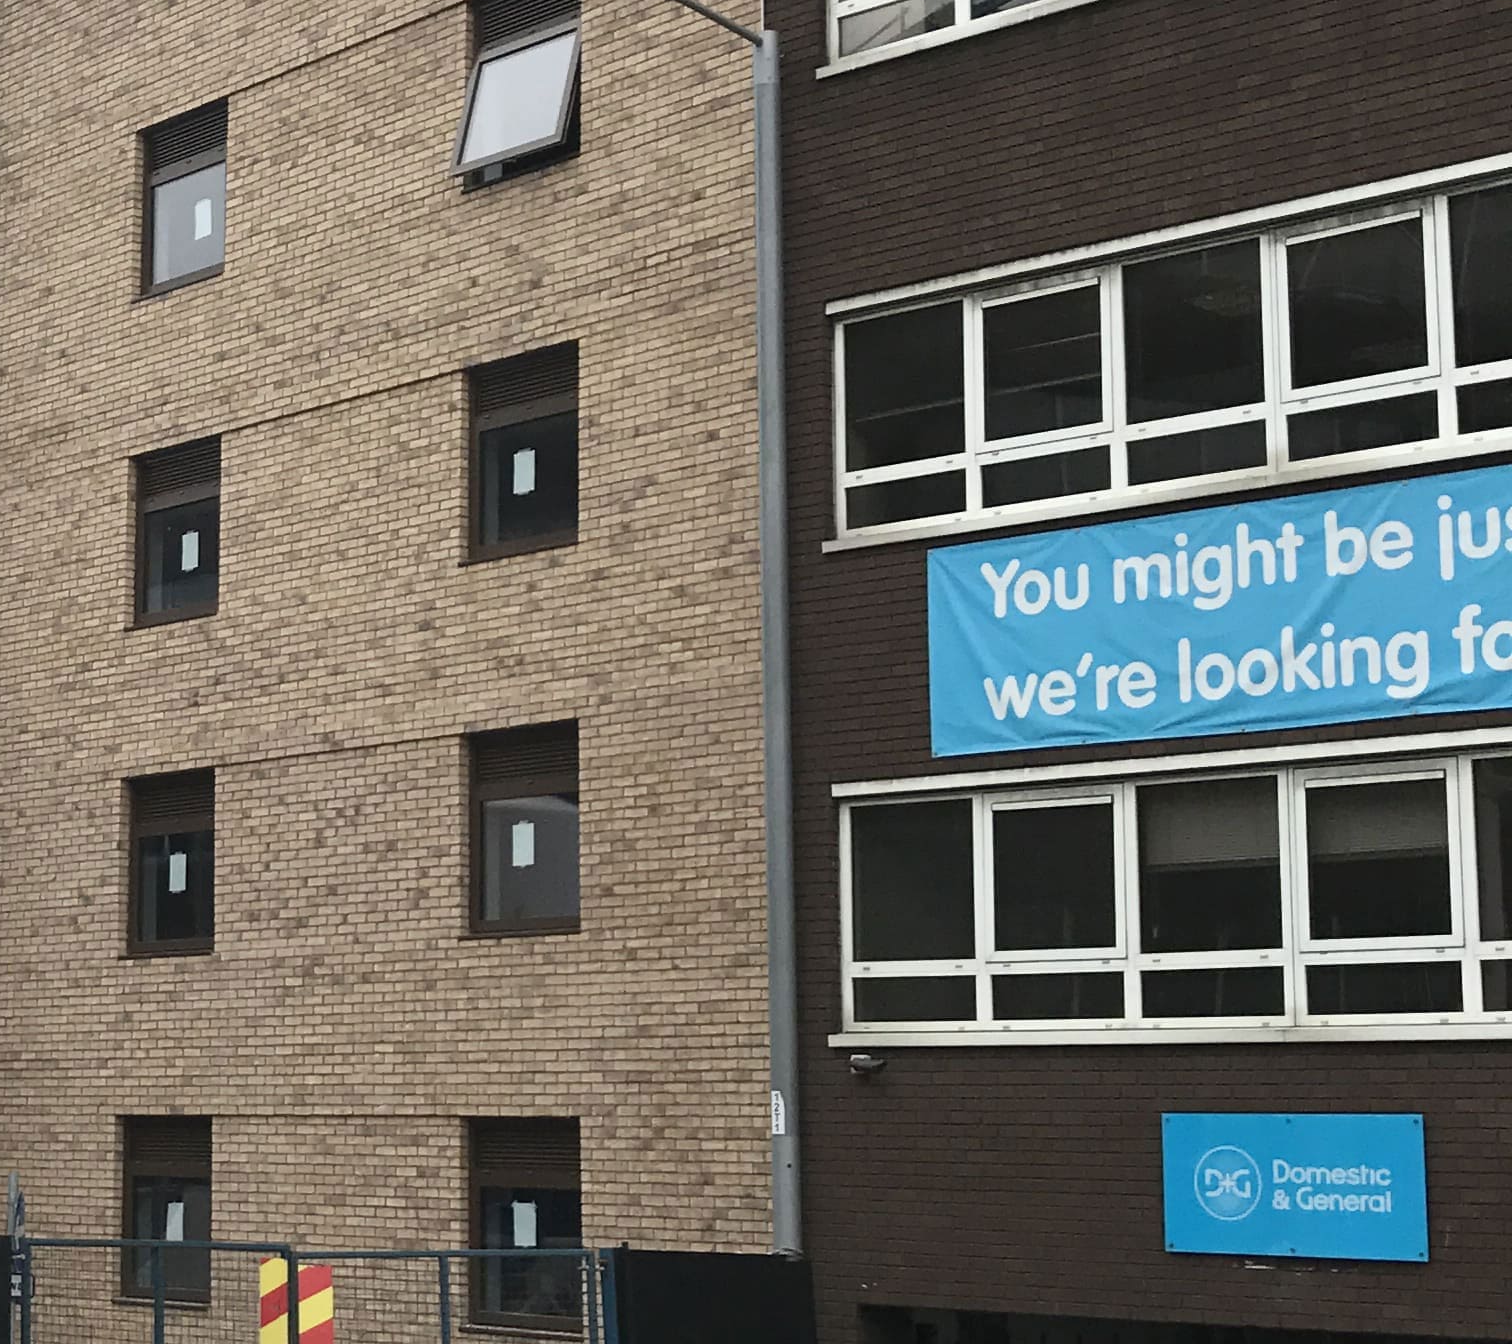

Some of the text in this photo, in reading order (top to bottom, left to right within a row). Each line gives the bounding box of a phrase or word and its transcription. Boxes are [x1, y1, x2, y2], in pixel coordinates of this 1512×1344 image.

[981, 558, 1089, 617] You
[1113, 523, 1304, 610] might
[1325, 511, 1413, 576] be
[984, 653, 1156, 720] we're
[1179, 623, 1429, 699] looking
[1272, 1159, 1391, 1186] Domestic
[1272, 1187, 1392, 1213] & General
